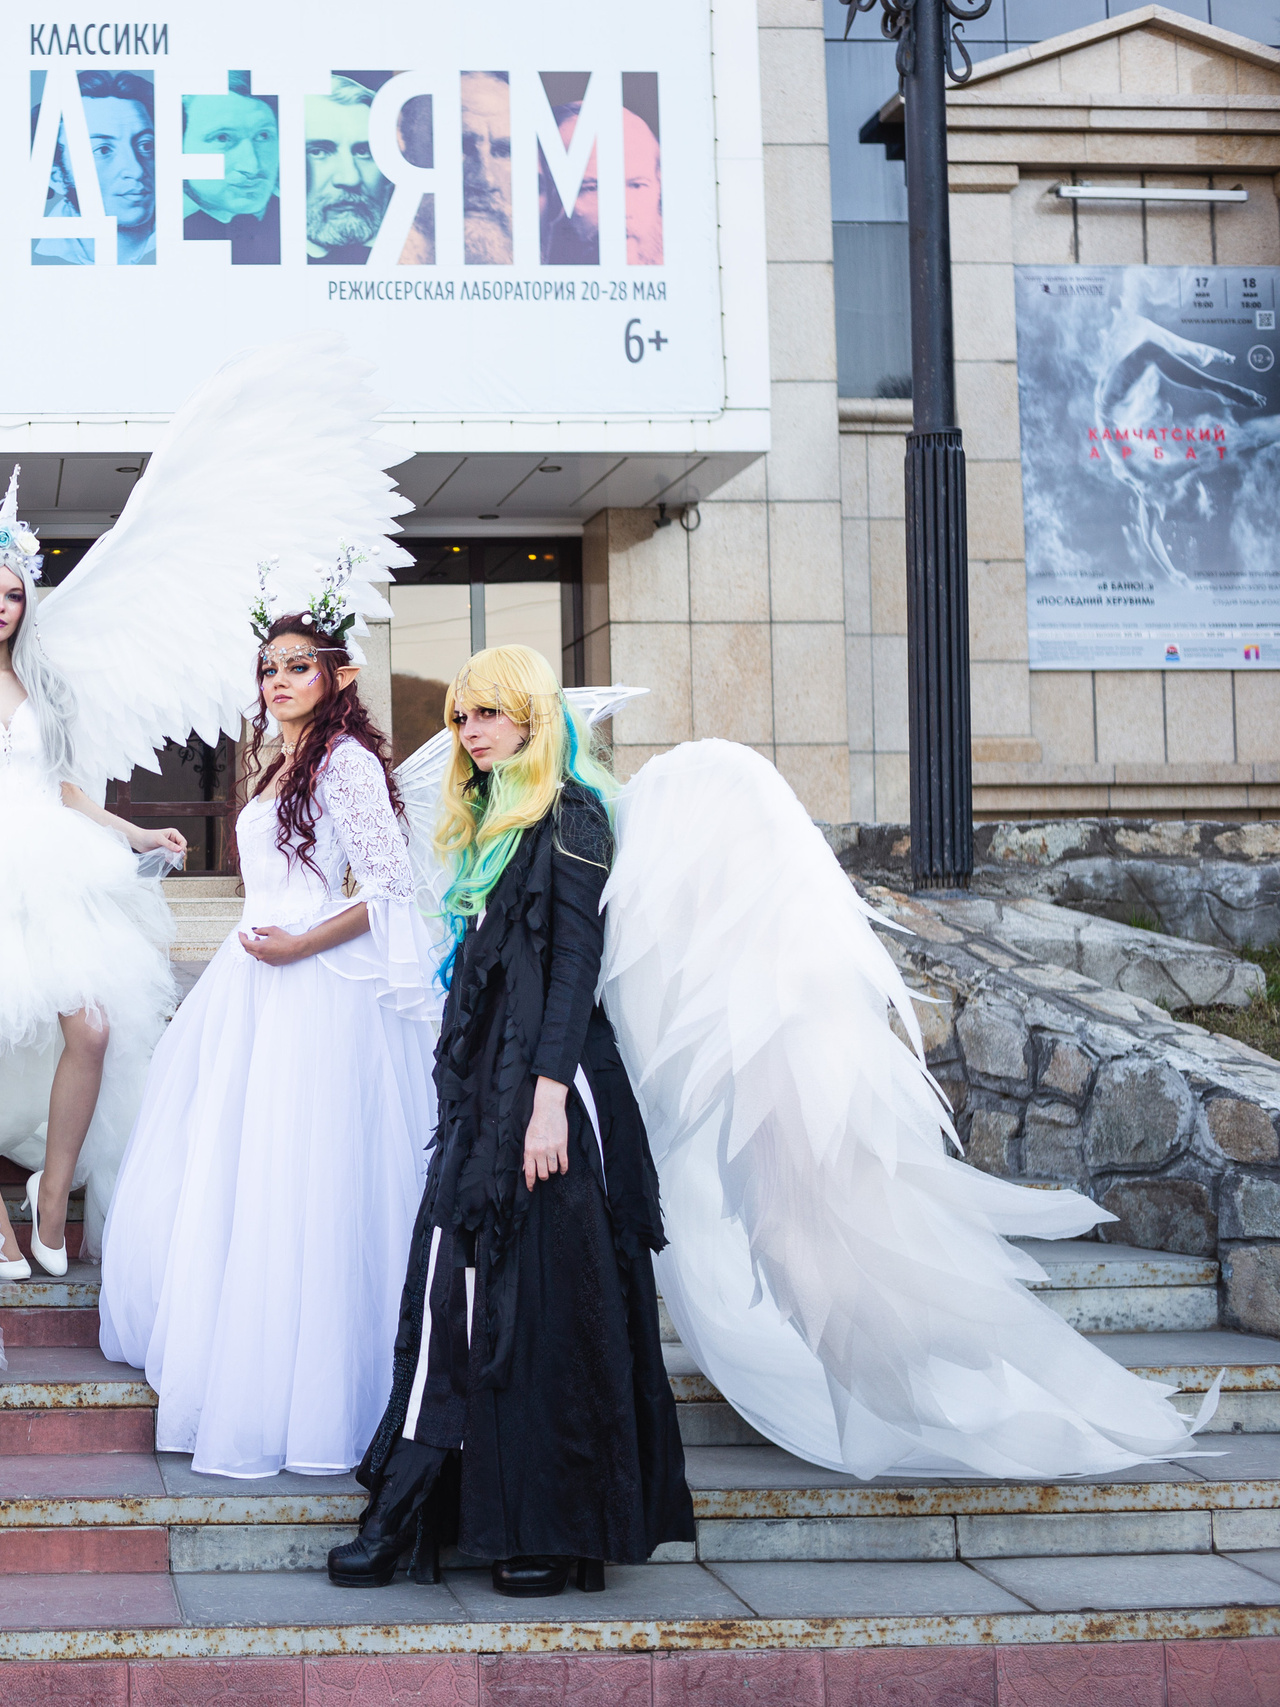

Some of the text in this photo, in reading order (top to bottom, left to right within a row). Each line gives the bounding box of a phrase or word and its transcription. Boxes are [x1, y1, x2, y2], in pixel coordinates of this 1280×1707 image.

[30, 23, 169, 56] КЛАССИКИ
[29, 69, 664, 266] ДЕТЯМ
[328, 280, 667, 301] РЕЖИССЕРСКАЯ ЛАБОРАТОРИЯ 20-28 МАЯ
[1195, 277, 1209, 288] 17
[1242, 277, 1257, 289] 18
[623, 317, 669, 364] 6+
[1088, 425, 1226, 441] КАМЧАТСКИЙ
